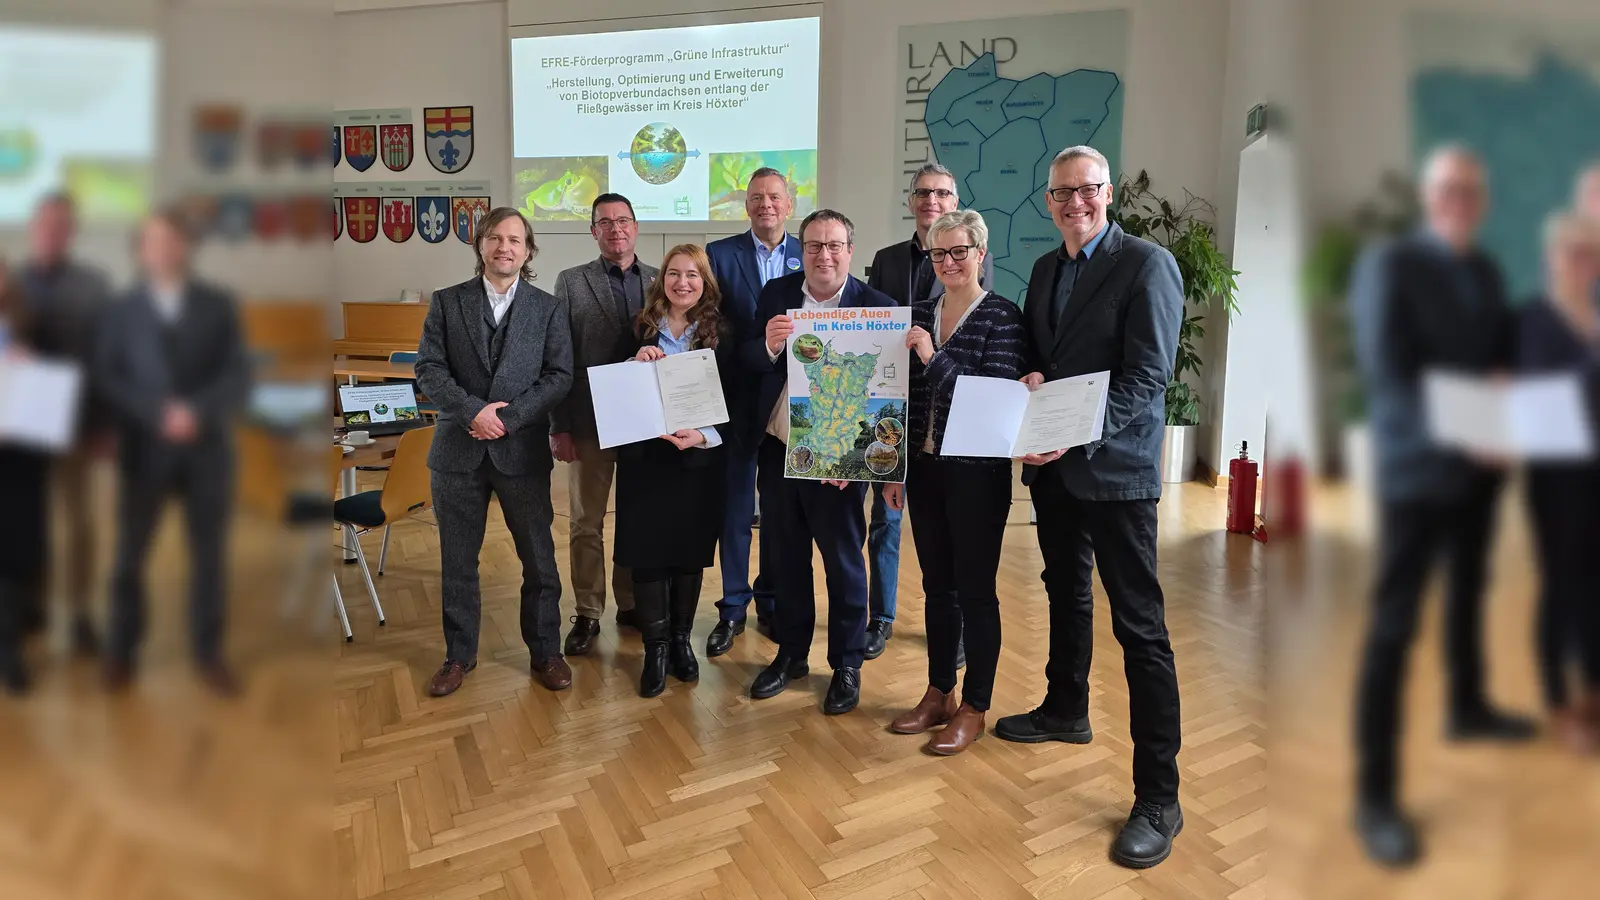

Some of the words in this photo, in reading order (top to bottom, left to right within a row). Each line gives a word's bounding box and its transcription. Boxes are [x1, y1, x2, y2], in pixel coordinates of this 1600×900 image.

[541, 53, 664, 68] EFRE-Förderprogramm
[667, 50, 708, 63] „Grüne
[711, 43, 790, 59] Infrastruktur“
[908, 37, 1018, 69] LAND
[546, 76, 615, 90] „Herstellung,
[617, 73, 686, 87] Optimierung
[689, 70, 711, 81] und
[714, 67, 784, 79] Erweiterung
[559, 92, 578, 101] von
[581, 86, 701, 102] Biotopverbundachsen
[704, 84, 747, 95] entlang
[750, 82, 770, 92] der
[577, 102, 654, 115] Fließgewässer
[656, 101, 670, 111] im
[673, 99, 703, 110] Kreis
[706, 97, 749, 108] Höxter“
[793, 309, 857, 320] Lebendige
[860, 308, 891, 319] Auen
[813, 322, 828, 331] im
[831, 320, 863, 331] Kreis
[866, 320, 907, 331] Höxter
